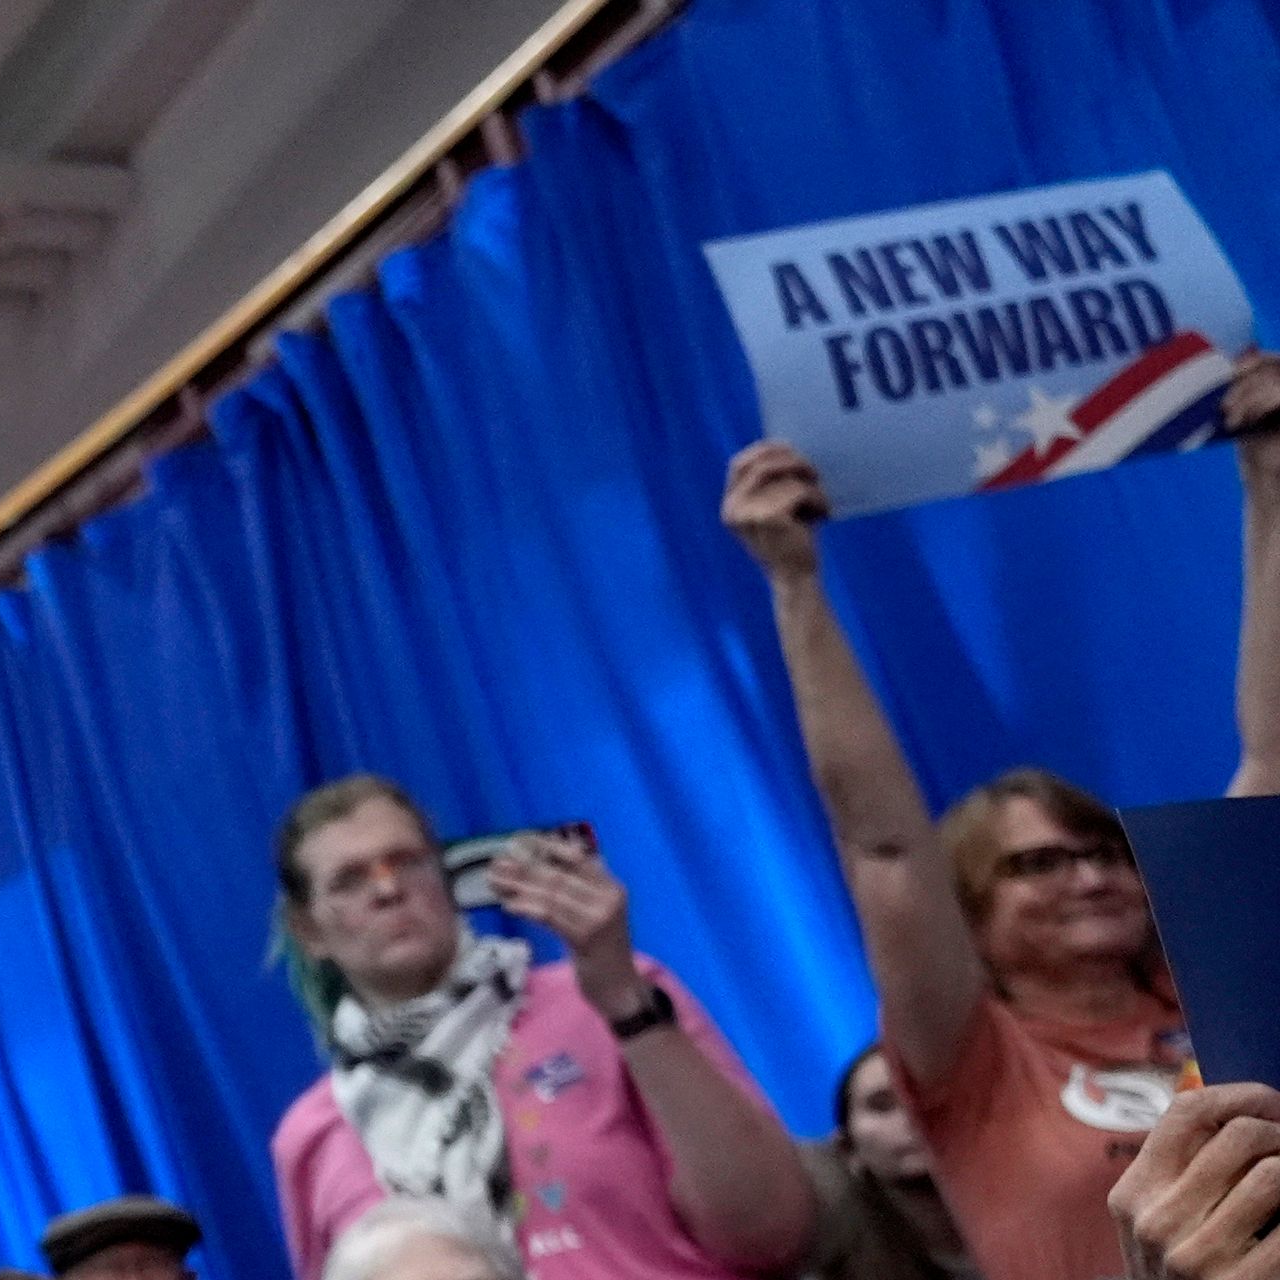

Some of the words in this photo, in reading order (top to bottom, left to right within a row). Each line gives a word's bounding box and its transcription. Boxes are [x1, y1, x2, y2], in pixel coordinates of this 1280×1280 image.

[769, 261, 831, 330] A
[826, 228, 992, 317] NEW
[996, 202, 1158, 282] WAY
[826, 281, 1174, 409] FORWARD
